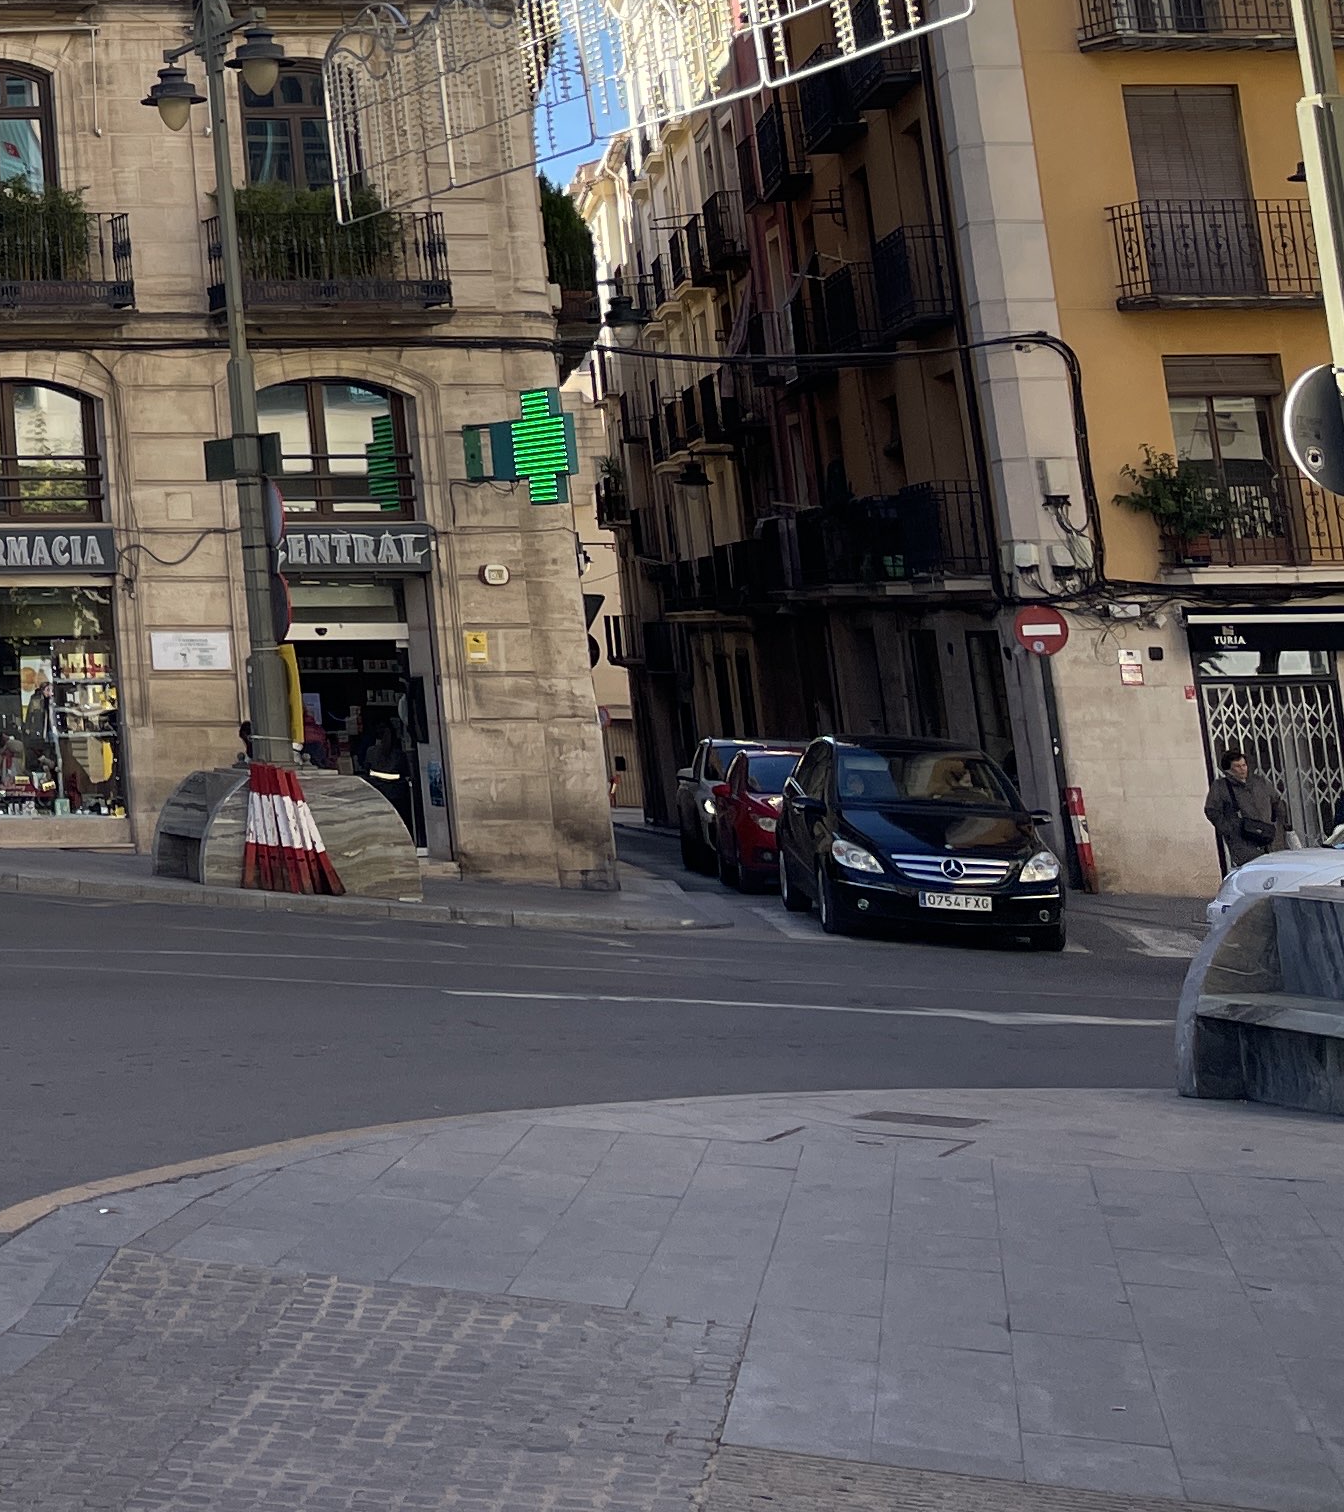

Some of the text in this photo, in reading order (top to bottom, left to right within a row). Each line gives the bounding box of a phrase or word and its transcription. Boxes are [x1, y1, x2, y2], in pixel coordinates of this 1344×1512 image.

[1214, 635, 1246, 645] TURIA
[927, 894, 989, 909] 0754 FXG
